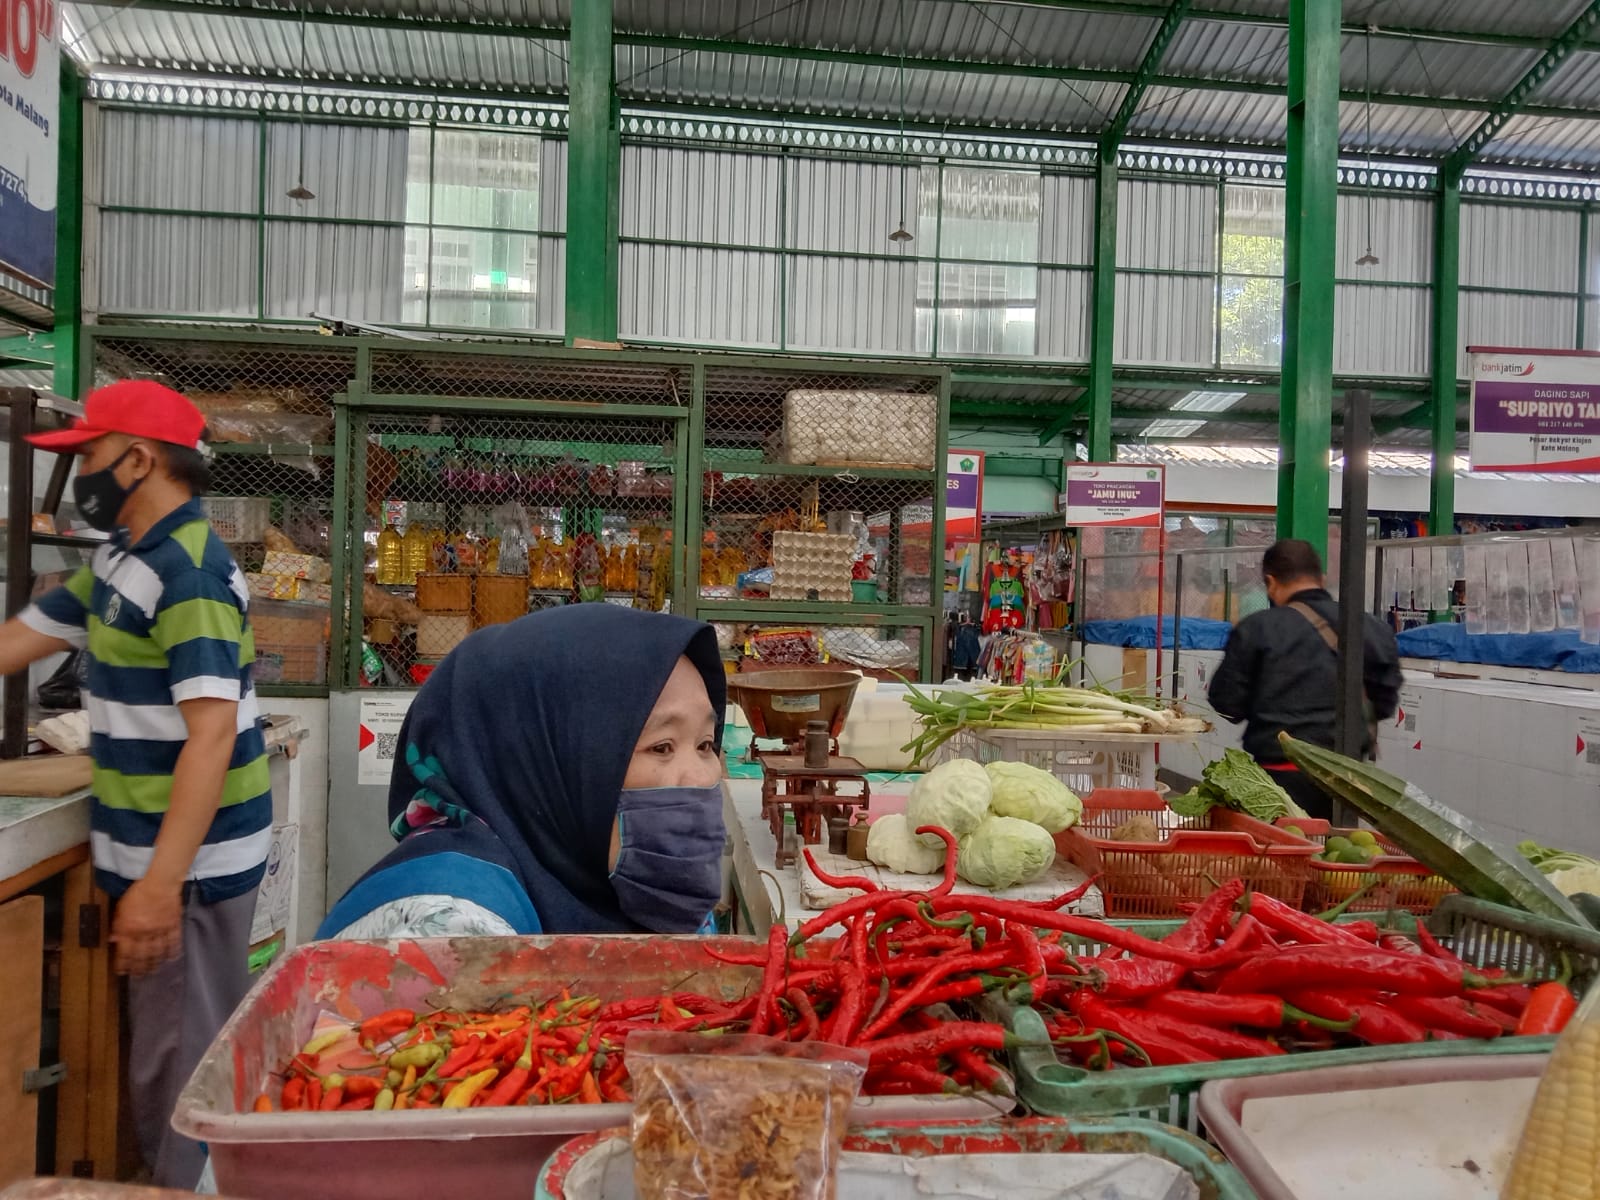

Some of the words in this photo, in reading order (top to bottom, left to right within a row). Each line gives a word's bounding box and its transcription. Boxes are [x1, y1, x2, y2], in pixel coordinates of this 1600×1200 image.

[16, 94, 49, 138] Malang
[1482, 362, 1523, 374] bankjatim
[1534, 390, 1568, 399] DAGING
[1570, 390, 1590, 399] SAPI
[1499, 400, 1574, 418] "SUPRIYO
[1556, 445, 1580, 454] Malang
[1087, 489, 1115, 499] "JAMU
[1117, 489, 1141, 500] INUL"
